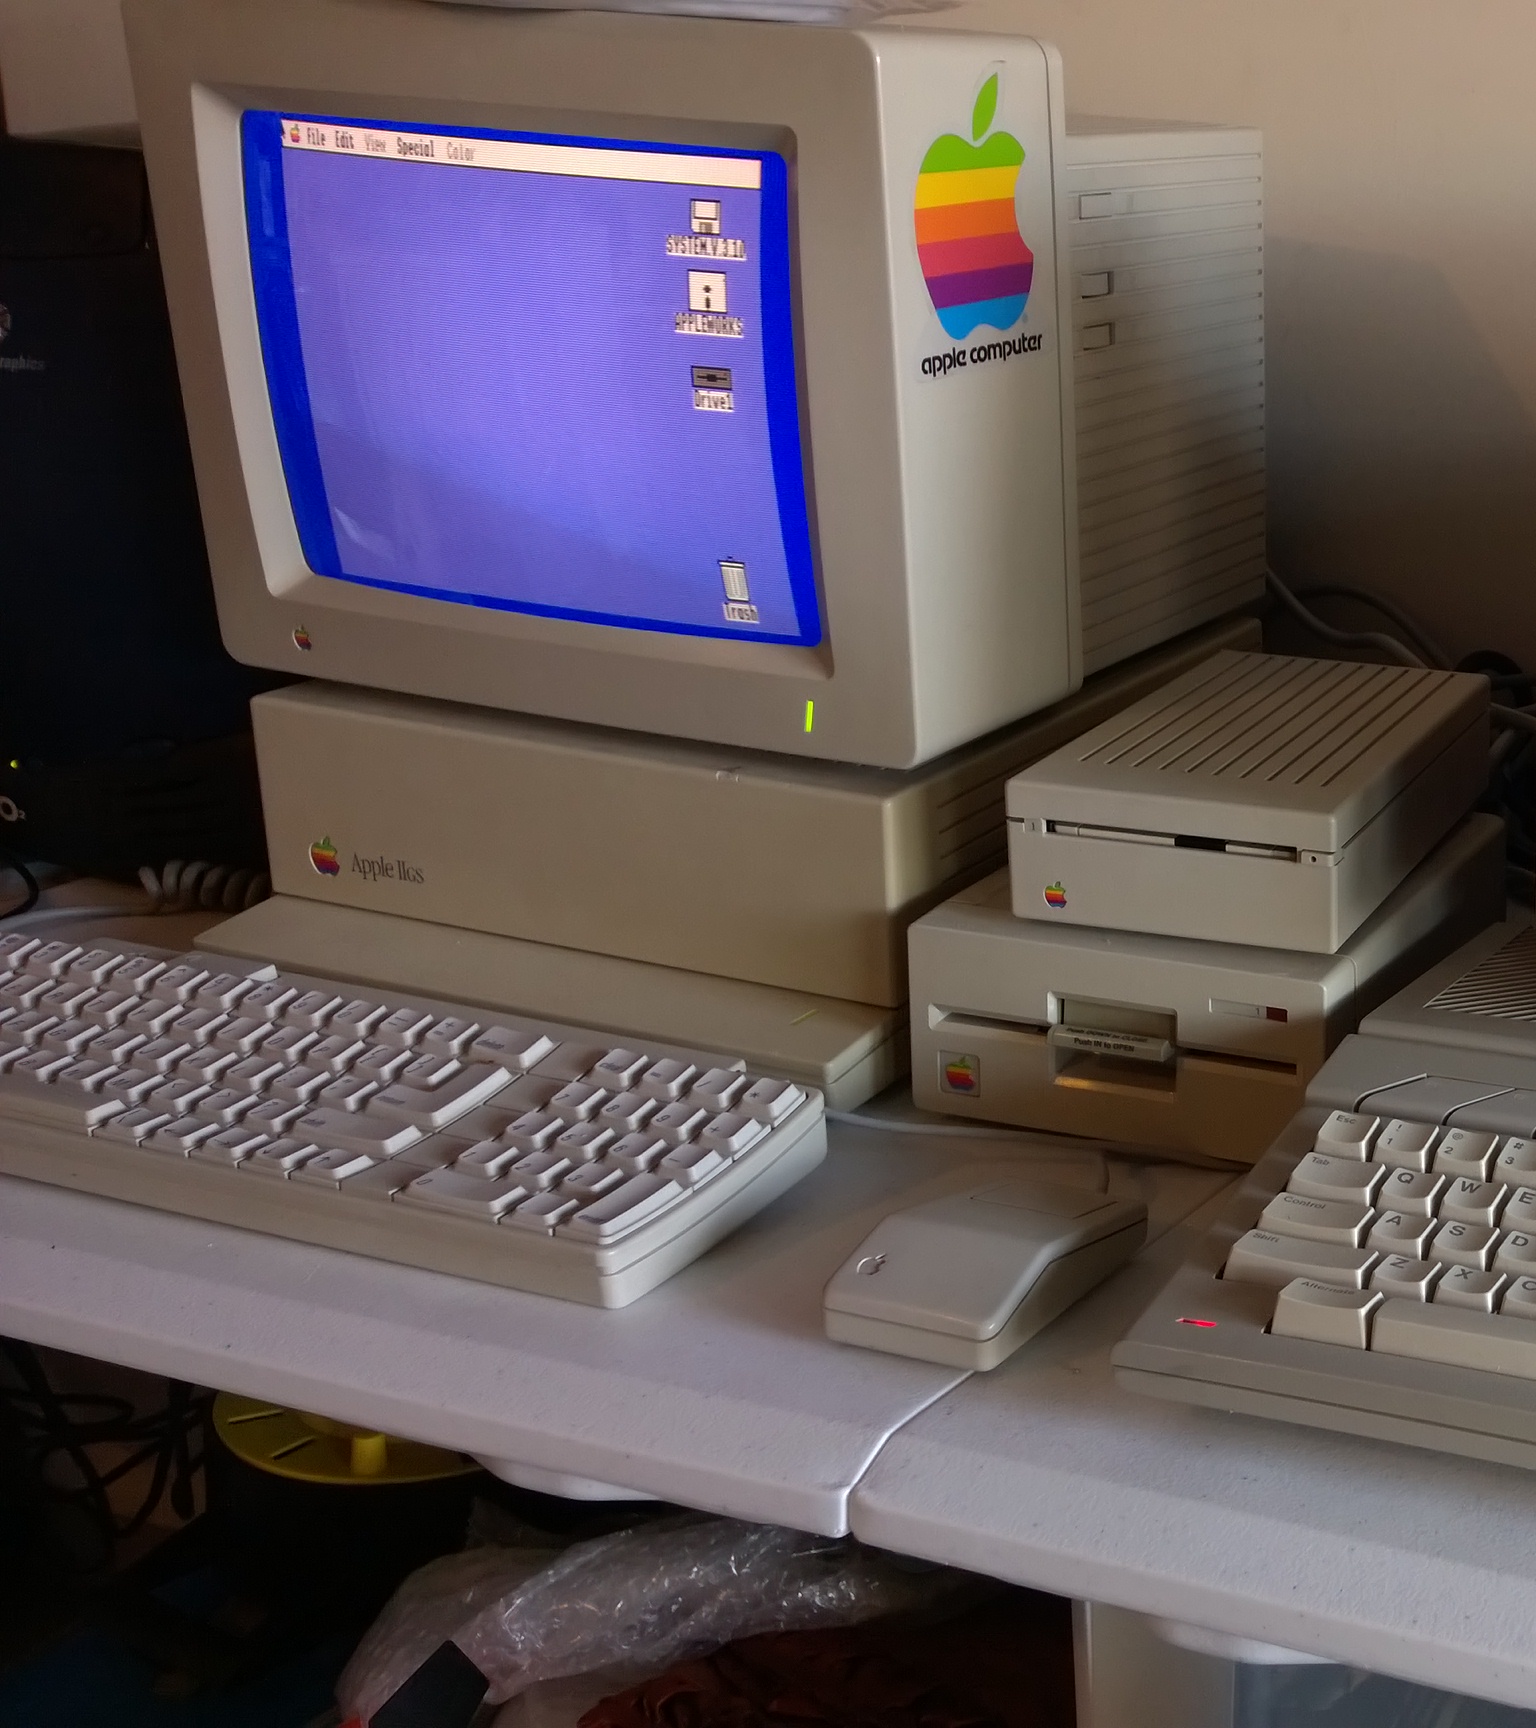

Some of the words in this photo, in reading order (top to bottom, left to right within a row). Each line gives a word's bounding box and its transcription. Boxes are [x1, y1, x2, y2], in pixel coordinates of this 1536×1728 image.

[307, 127, 326, 146] File
[335, 130, 355, 150] Edit
[364, 133, 386, 153] View
[397, 136, 435, 158] Special
[447, 142, 475, 161] Color
[921, 346, 967, 377] apple
[970, 333, 1042, 364] computer
[694, 390, 733, 410] Drive1
[725, 602, 758, 622] Trash
[352, 852, 394, 881] Apple
[1073, 1037, 1092, 1046] Push
[1093, 1040, 1102, 1048] IN
[1103, 1041, 1111, 1049] to
[1113, 1043, 1135, 1052] OPEN
[1335, 1114, 1356, 1126] Esc
[1386, 1136, 1393, 1145] 1
[1443, 1146, 1453, 1155] 2
[1310, 1155, 1330, 1167] Tab
[1504, 1155, 1515, 1165] 3
[1397, 1171, 1414, 1186] Q
[1460, 1180, 1482, 1194] W
[1283, 1194, 1327, 1210] Control
[1518, 1191, 1535, 1205] E
[1386, 1214, 1402, 1226] A
[1252, 1231, 1280, 1244] Shift
[1448, 1225, 1466, 1237] S
[1510, 1234, 1529, 1247] D
[1389, 1257, 1408, 1269] Z
[1454, 1268, 1474, 1280] X
